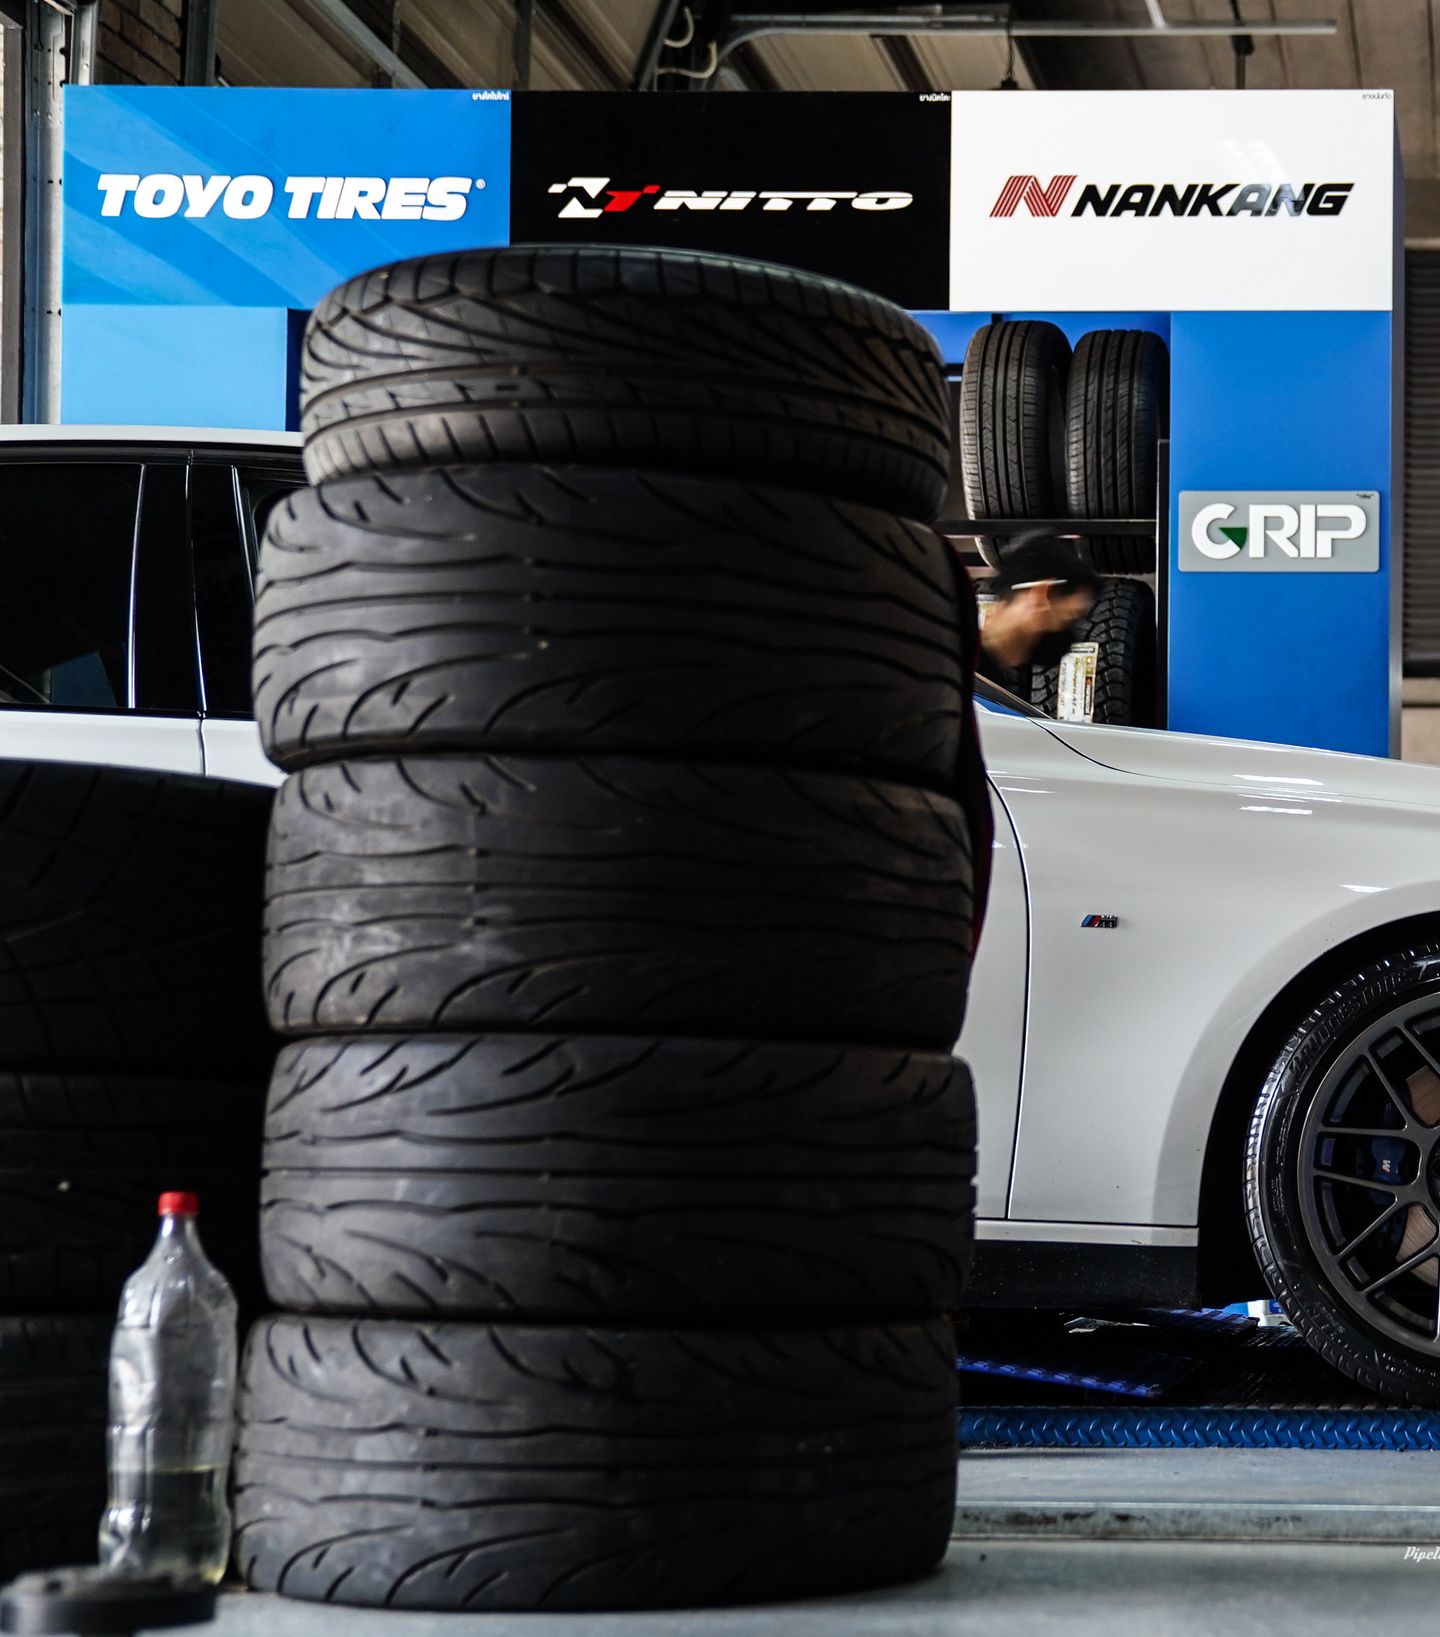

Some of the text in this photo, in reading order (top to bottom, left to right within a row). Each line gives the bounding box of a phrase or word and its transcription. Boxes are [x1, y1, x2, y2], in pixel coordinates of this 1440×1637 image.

[97, 174, 472, 222] TOYO TIRES
[653, 191, 914, 210] NITTO
[1071, 183, 1355, 217] NANKANG
[1191, 503, 1367, 560] GRIP
